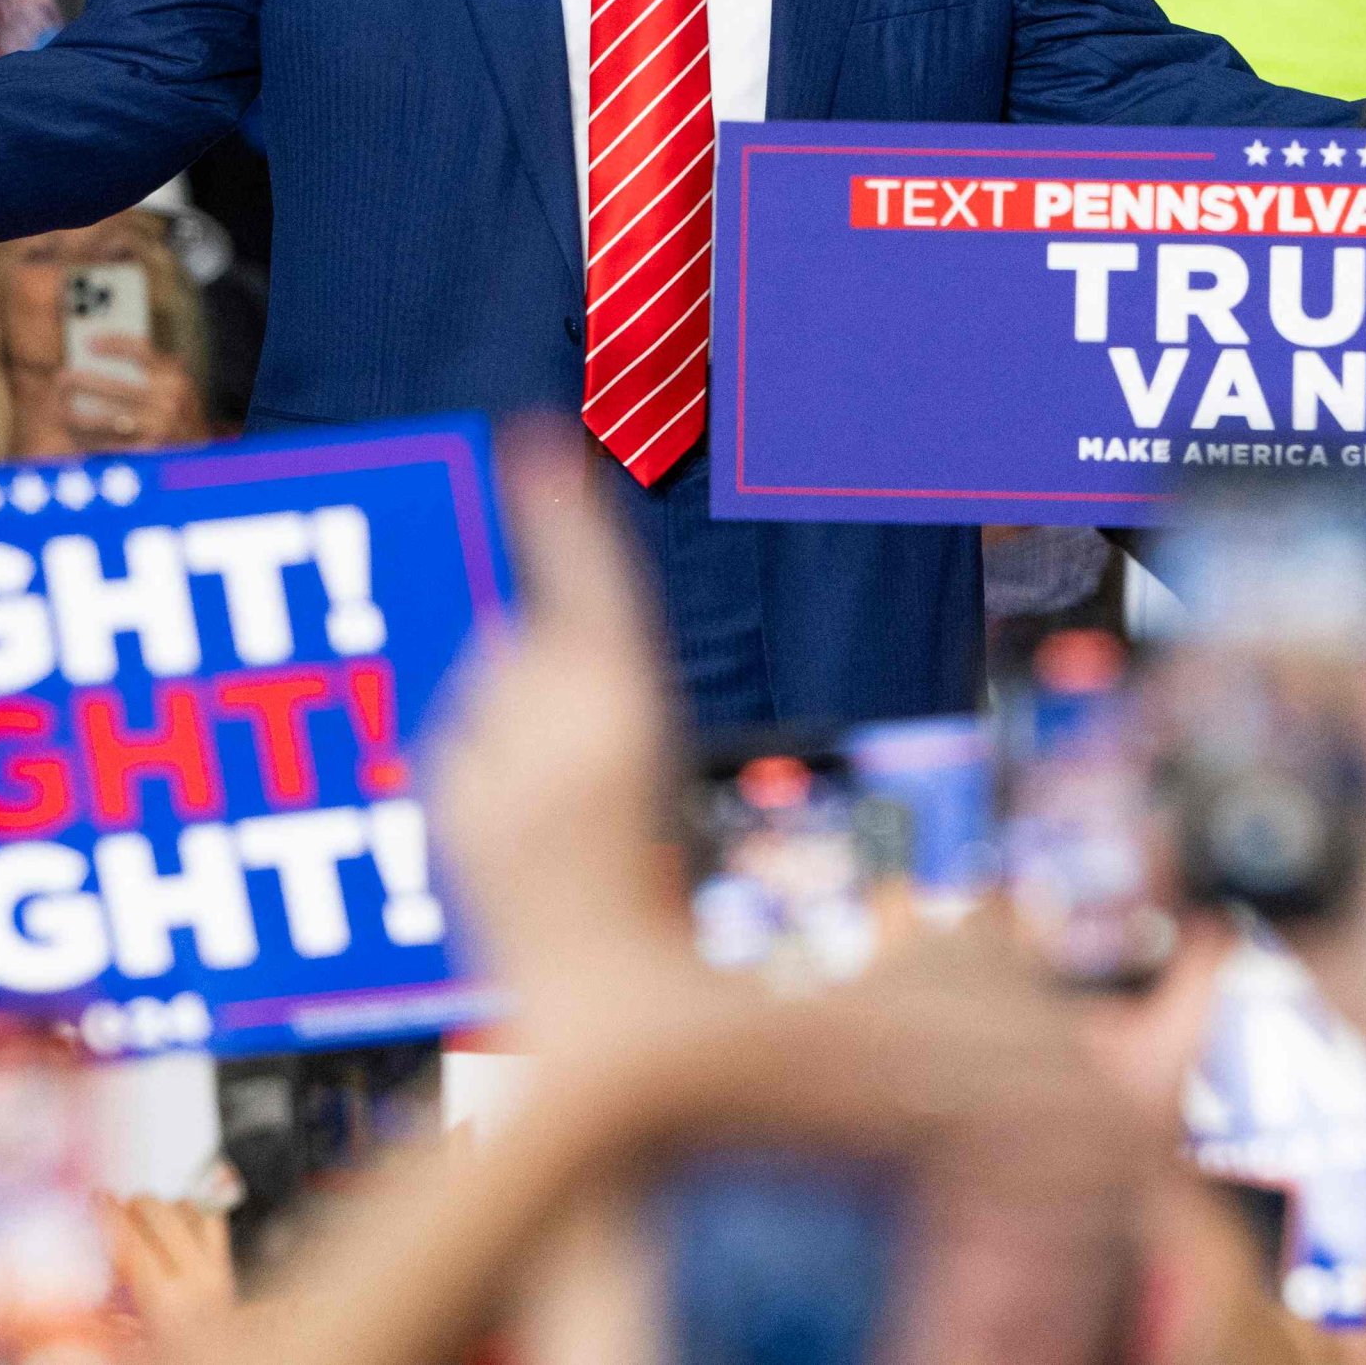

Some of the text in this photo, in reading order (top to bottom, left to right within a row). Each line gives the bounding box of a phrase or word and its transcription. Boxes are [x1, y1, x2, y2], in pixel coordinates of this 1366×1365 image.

[865, 179, 1017, 229] TEXT
[1078, 437, 1172, 464] MAKE
[1182, 441, 1330, 468] AMERICA
